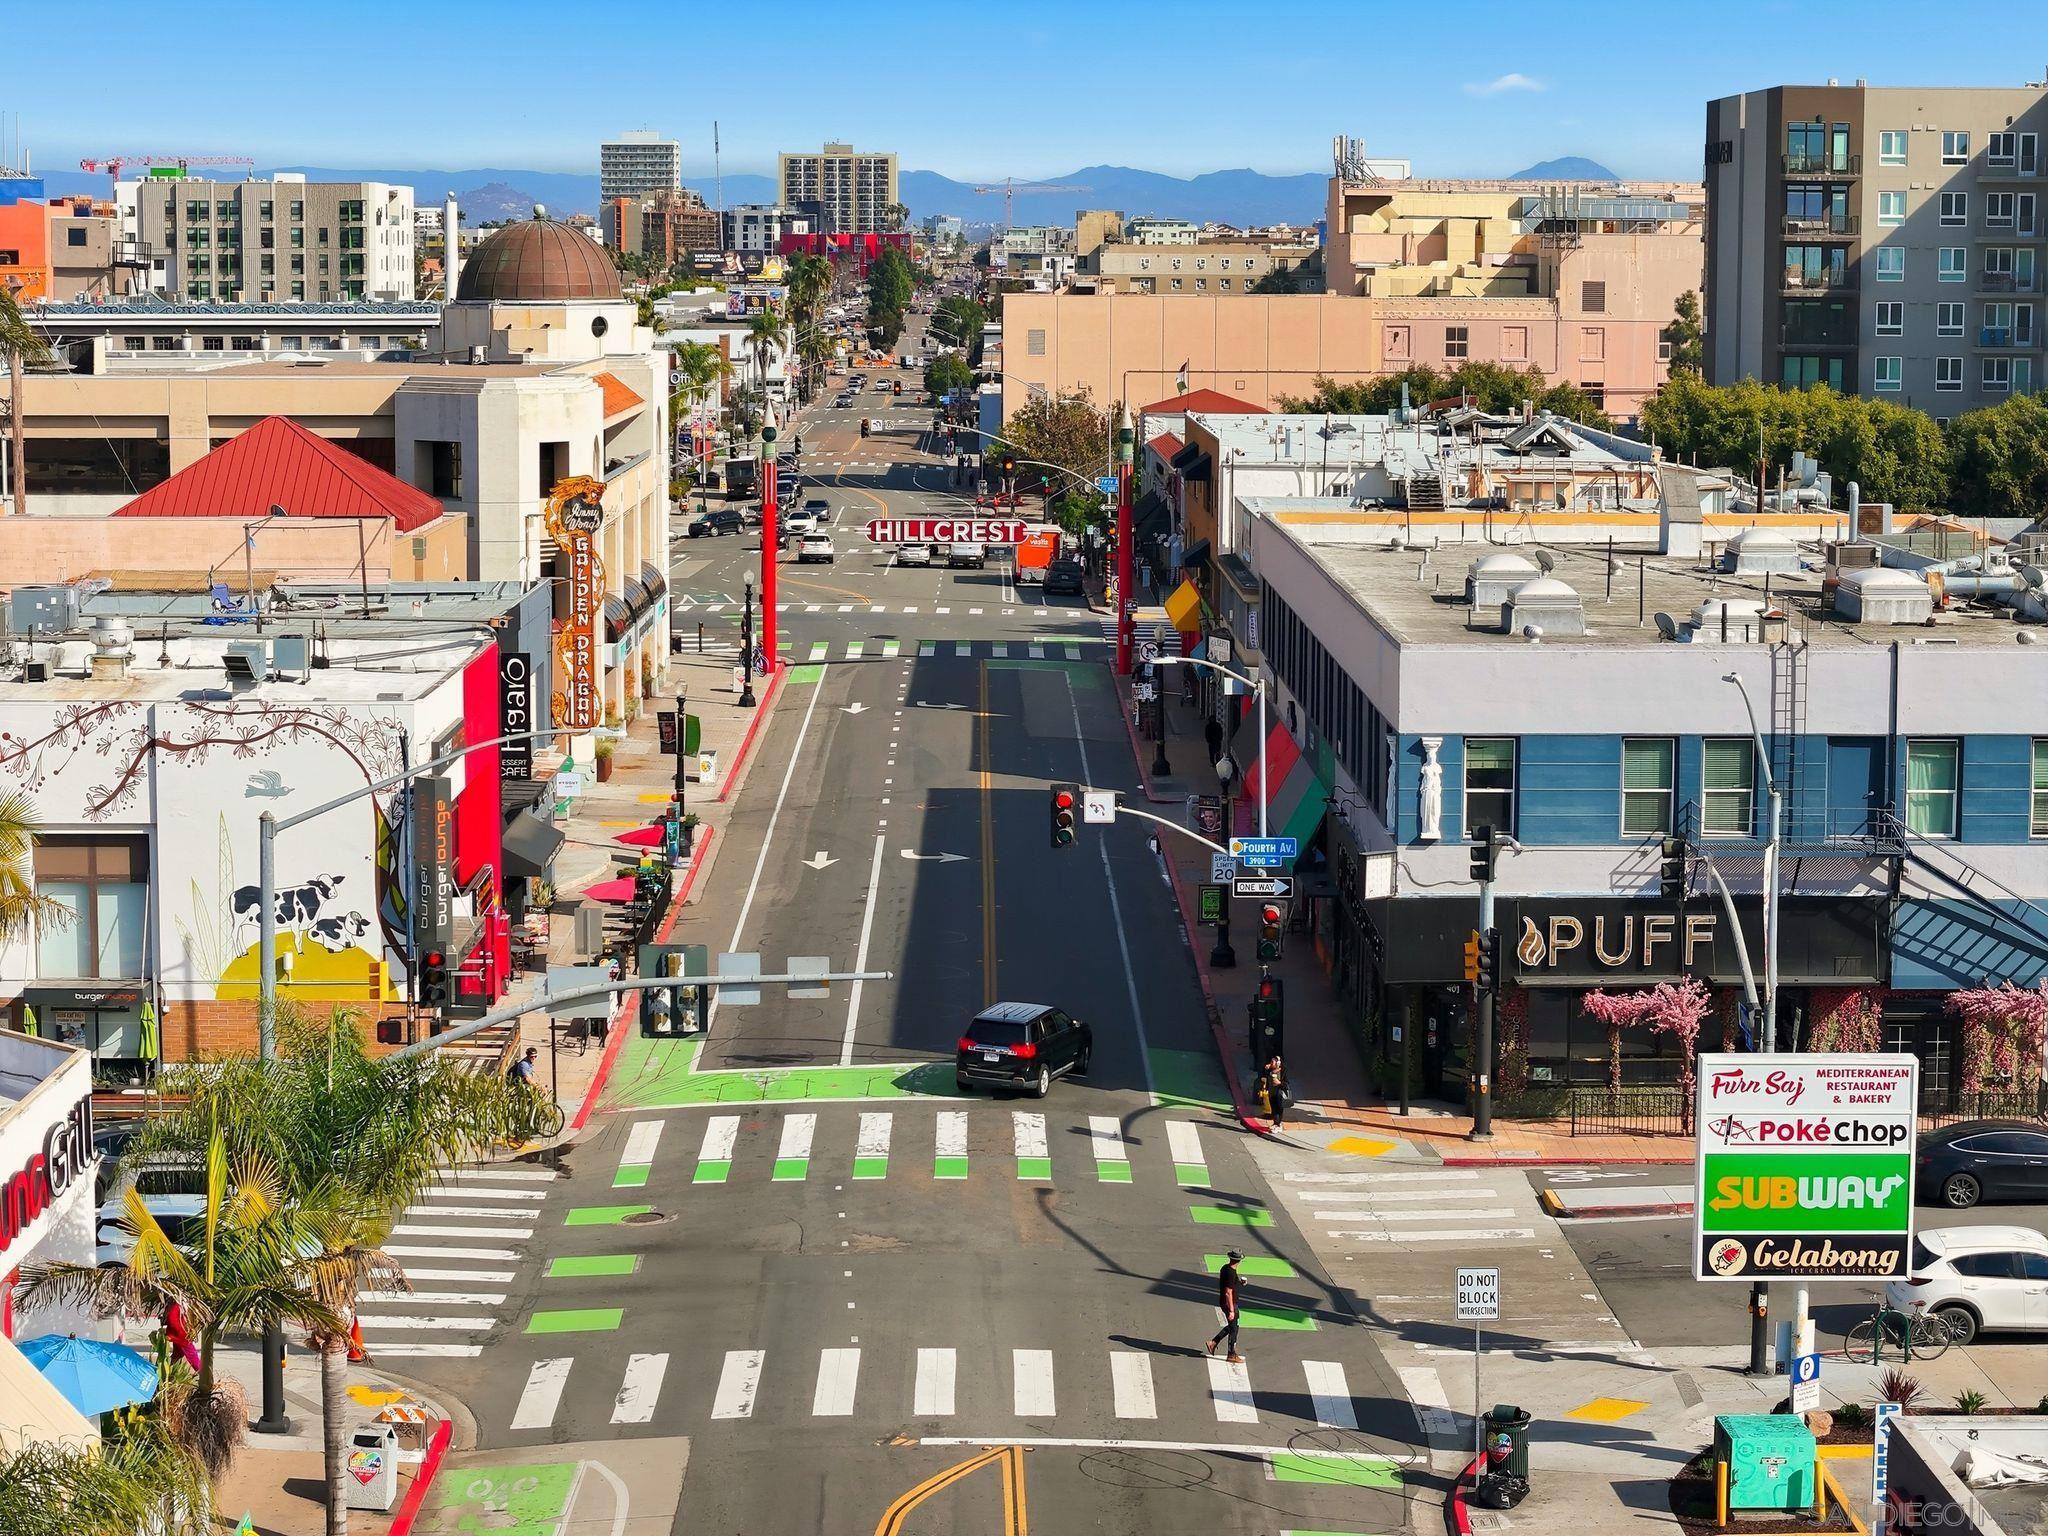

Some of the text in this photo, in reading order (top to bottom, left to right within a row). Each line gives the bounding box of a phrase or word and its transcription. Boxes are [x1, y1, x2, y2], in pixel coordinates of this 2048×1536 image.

[565, 503, 600, 524] Jimmy
[875, 521, 1021, 542] HILLCREST
[574, 537, 591, 727] GOLDEN DRAGON
[1243, 842, 1276, 853] FOURTH
[1214, 869, 1234, 880] 20
[1239, 883, 1275, 891] ONE WAY
[1549, 915, 1717, 967] PUFF
[1816, 1069, 1910, 1078] MEDITERRANEAN
[1711, 1068, 1806, 1106] Furn Saj
[1826, 1081, 1898, 1091] RESTAURANT
[1832, 1094, 1892, 1104] & BAKERY
[43, 1094, 99, 1198] Grill
[1709, 1174, 1906, 1211] SUBWAY
[1753, 1239, 1900, 1275] Gelabong
[1459, 1274, 1496, 1287] DO NOT
[1459, 1291, 1497, 1304] BLOCK
[1458, 1306, 1497, 1315] INTERSECTION
